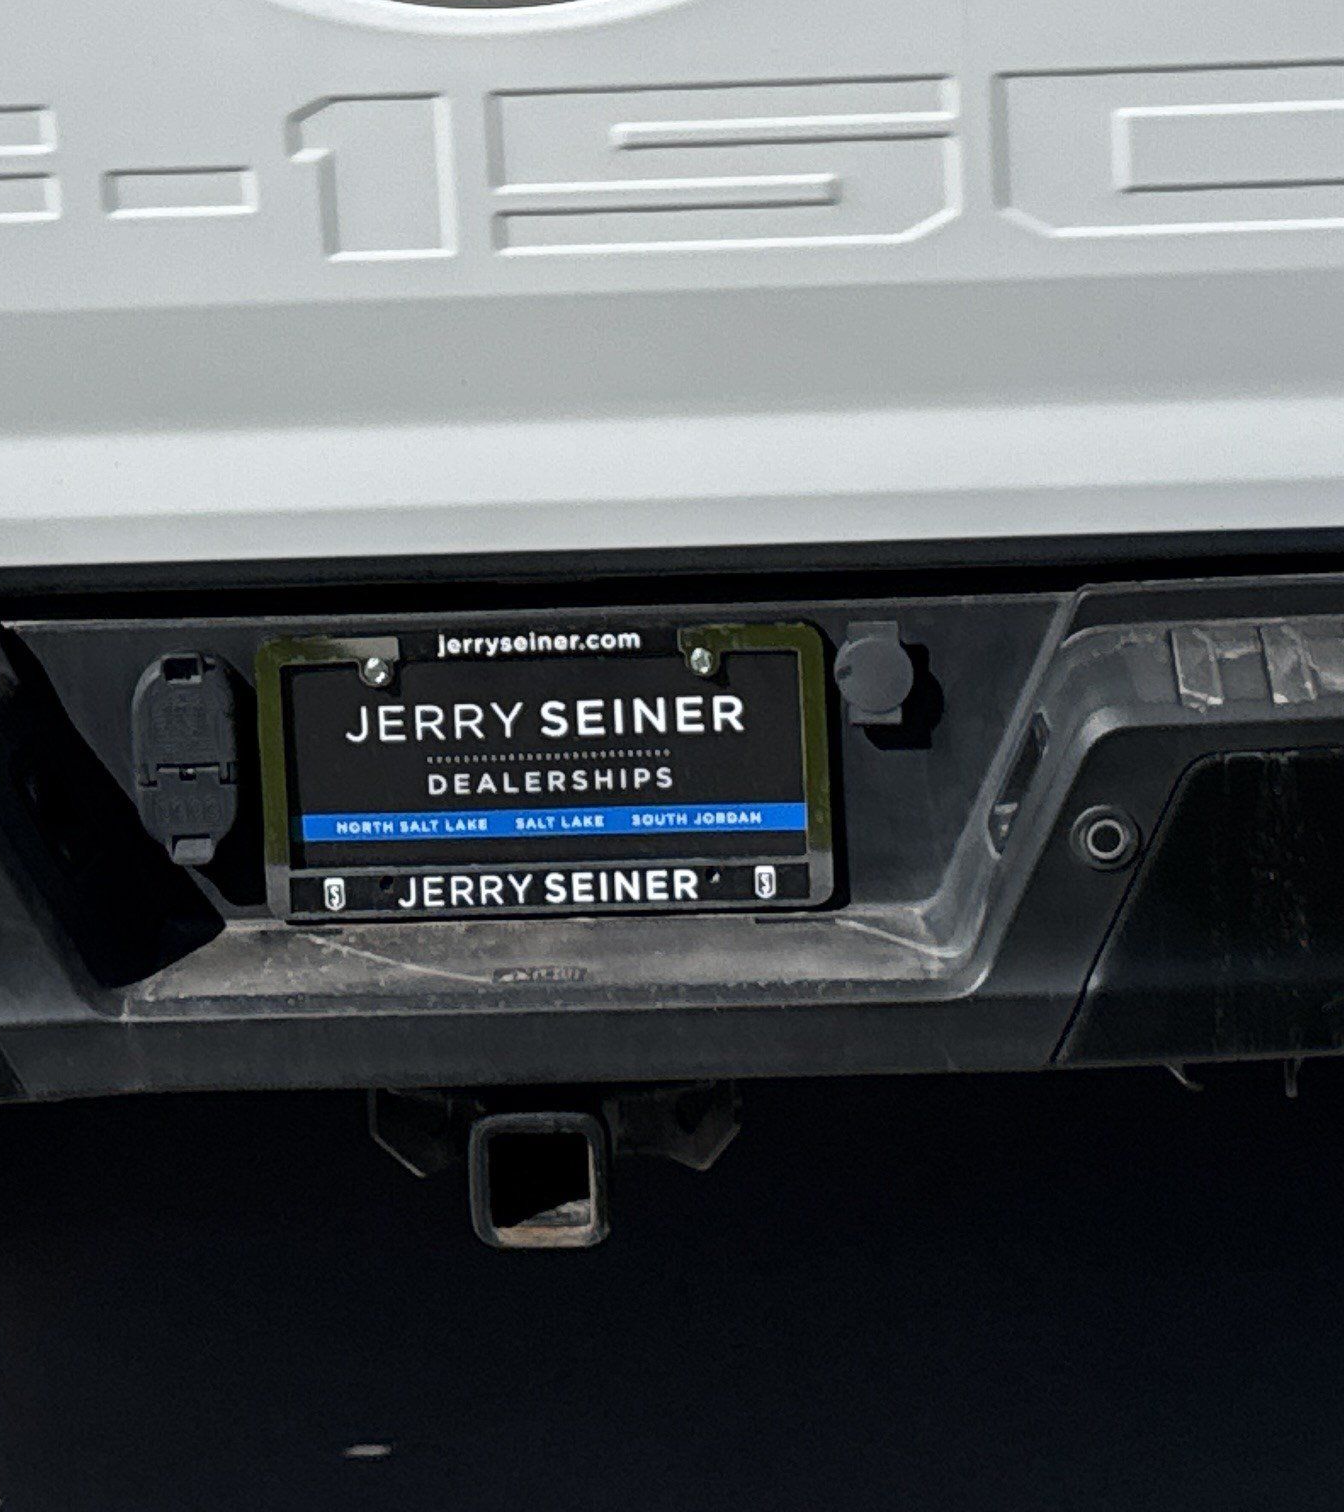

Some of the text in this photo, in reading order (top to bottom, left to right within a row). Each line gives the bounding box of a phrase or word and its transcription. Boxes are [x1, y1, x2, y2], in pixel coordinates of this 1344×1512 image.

[436, 630, 641, 658] jerryseiner.com
[345, 695, 746, 743] JERRY SEINER
[427, 766, 674, 796] DEALERSHIPS
[336, 817, 489, 835] NORTH SALT LAKE
[515, 815, 605, 831] SALT LAKE
[632, 811, 763, 827] SOUTH JORDAN
[398, 869, 699, 908] JERRY SEINER
